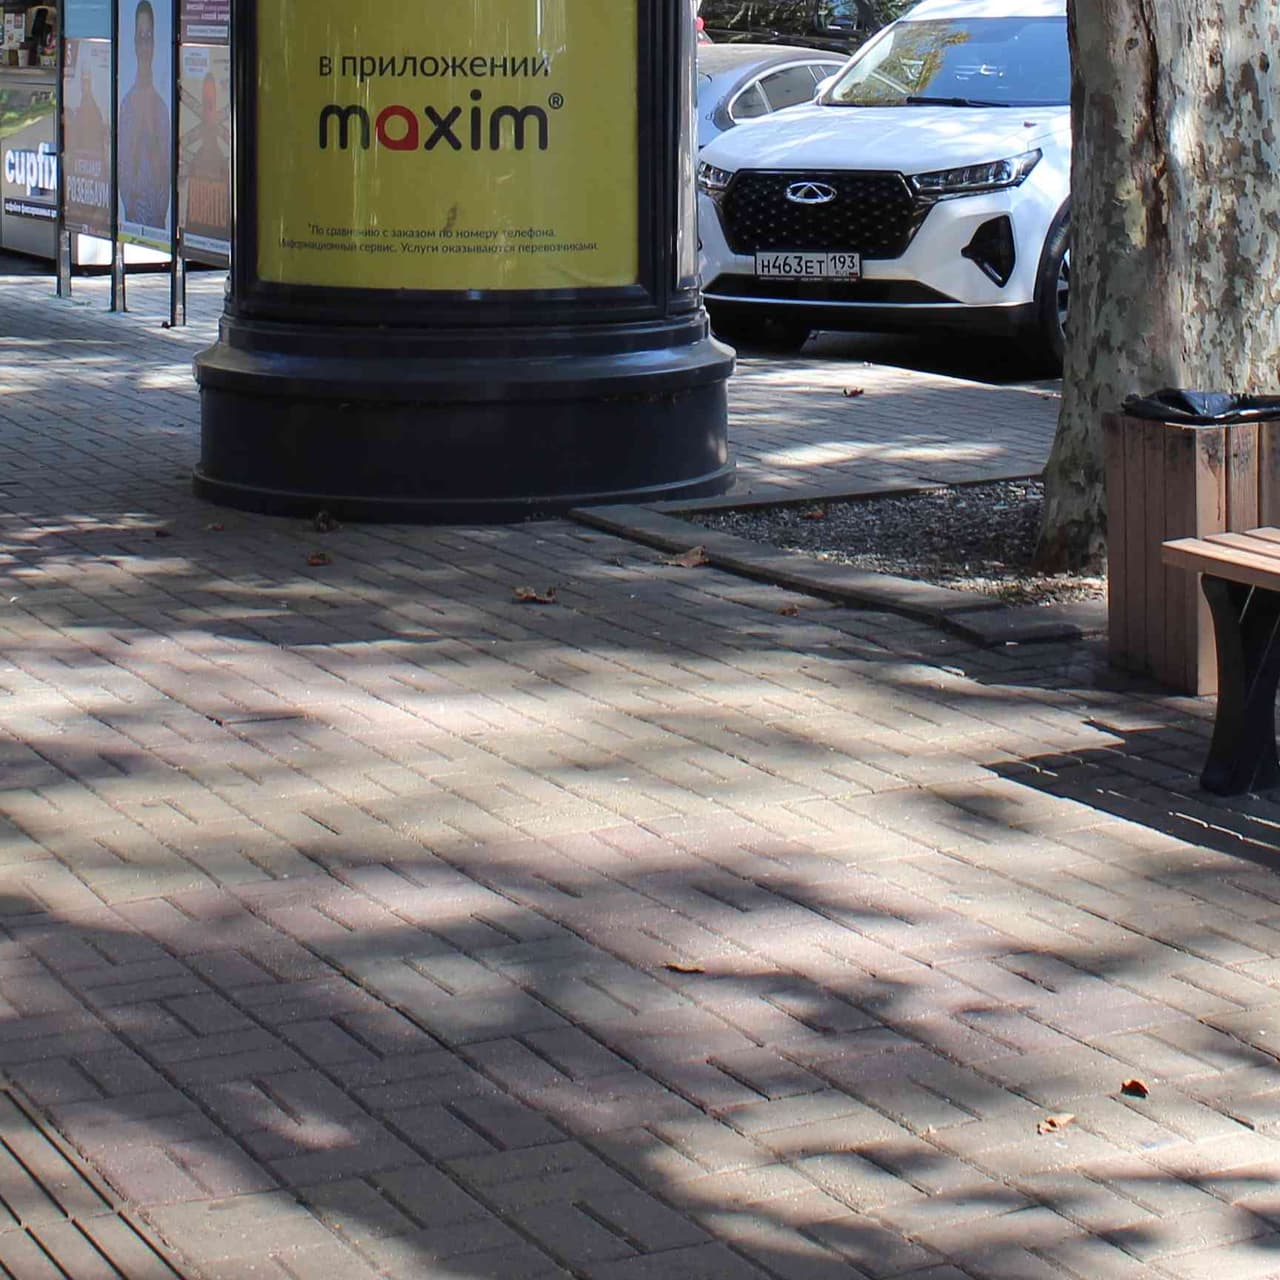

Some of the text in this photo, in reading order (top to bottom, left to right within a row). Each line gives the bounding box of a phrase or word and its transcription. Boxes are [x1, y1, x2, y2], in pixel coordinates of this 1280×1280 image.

[320, 55, 549, 83] в приложении
[391, 230, 437, 238] заказом
[439, 230, 452, 239] по
[456, 230, 497, 240] номеру
[401, 242, 439, 255] Услуги
[442, 244, 515, 254] оказываются
[830, 255, 855, 269] 193
